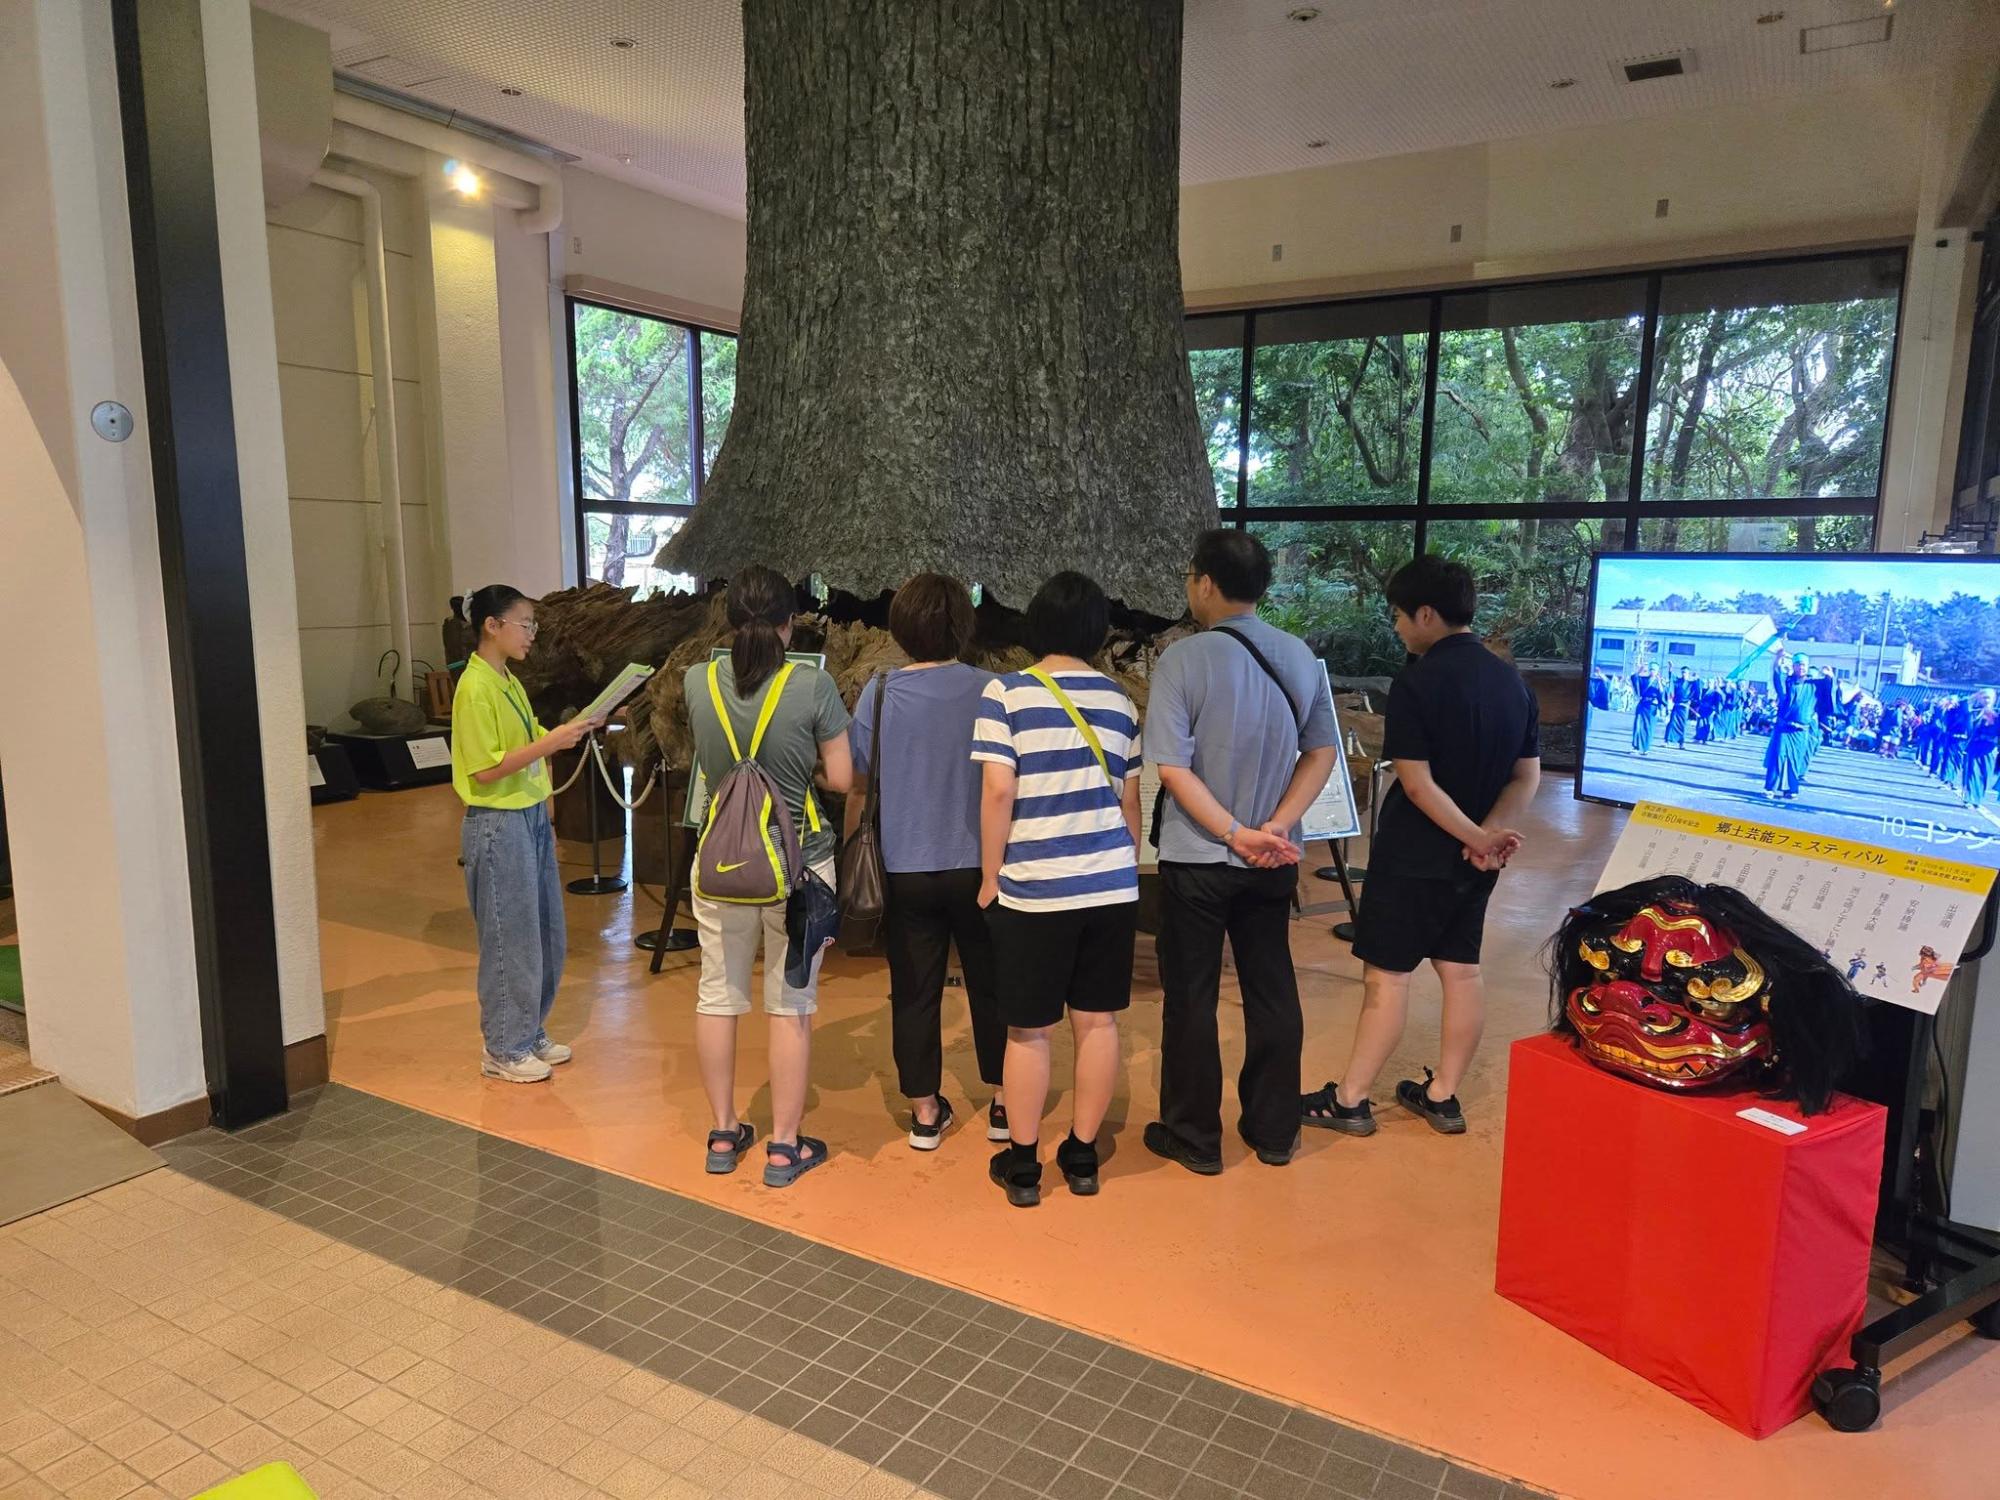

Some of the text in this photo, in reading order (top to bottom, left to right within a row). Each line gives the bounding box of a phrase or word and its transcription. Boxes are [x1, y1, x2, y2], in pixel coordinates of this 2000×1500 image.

[1715, 821, 1889, 865] 郷土芸能フェスティバル
